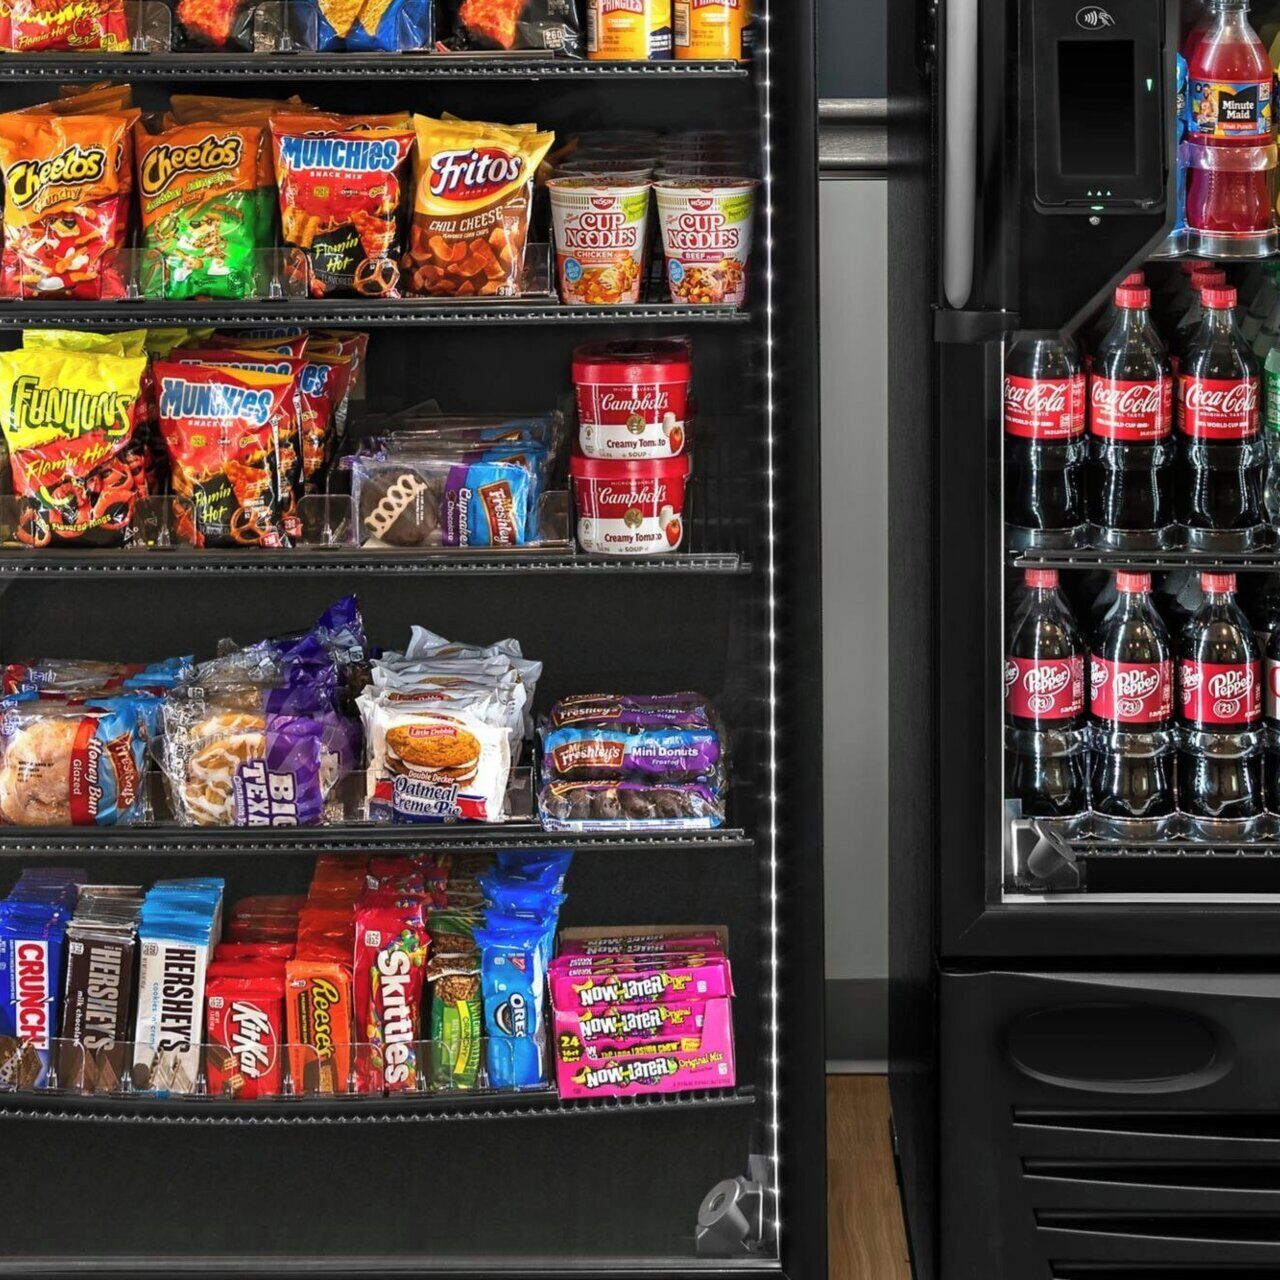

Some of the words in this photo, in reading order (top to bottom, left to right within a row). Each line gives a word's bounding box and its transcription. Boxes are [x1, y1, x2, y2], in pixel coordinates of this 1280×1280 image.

[1222, 100, 1254, 111] Minute
[1227, 110, 1250, 119] Maid
[281, 136, 399, 171] MUNCHIES
[7, 146, 107, 205] Cheetos
[142, 136, 242, 197] Cheetos
[430, 148, 522, 196] Fritos
[429, 220, 458, 232] CHILI
[459, 205, 504, 231] CHEESE
[580, 212, 626, 231] CUP
[679, 213, 726, 231] CUP
[565, 227, 636, 248] NOODLES
[668, 228, 739, 250] NOODLES
[326, 255, 353, 273] Hot
[10, 375, 133, 438] FUNYUNS
[600, 392, 668, 415] Campbell's
[1091, 380, 1162, 413] Coca-Cola
[1185, 382, 1257, 413] Coca-Cola
[606, 440, 637, 450] Creamy
[598, 486, 666, 507] Campbell's
[203, 506, 228, 523] Hot
[604, 533, 635, 544] Creamy
[1028, 669, 1067, 694] Pepper
[1039, 666, 1057, 676] Dr
[1117, 673, 1157, 697] Pepper
[1214, 673, 1252, 698] Pepper
[1220, 703, 1231, 713] 23
[85, 737, 103, 782] Honey
[560, 746, 621, 765] Freshley's
[632, 747, 656, 757] Mini
[658, 747, 699, 757] Donuts
[72, 758, 82, 796] Glazed
[408, 770, 431, 780] Double
[432, 773, 455, 783] Decker
[88, 785, 103, 815] Bun
[395, 777, 459, 802] Oatmeal
[393, 791, 432, 813] Creme
[435, 800, 461, 816] Pie
[17, 943, 47, 1048] CRUNCH
[83, 947, 122, 1052] HERSHEY'S
[158, 947, 196, 1053] HERSHEY'S
[580, 983, 620, 1007] NOW
[74, 1006, 82, 1047] chocolate
[311, 978, 340, 1059] Reese's
[377, 950, 414, 1084] Skittles
[580, 1015, 618, 1038] NOW
[561, 1036, 580, 1047] 24
[679, 1056, 709, 1068] Original
[710, 1051, 724, 1062] Mix
[586, 1064, 624, 1088] NOW
[627, 1058, 669, 1080] LATER
